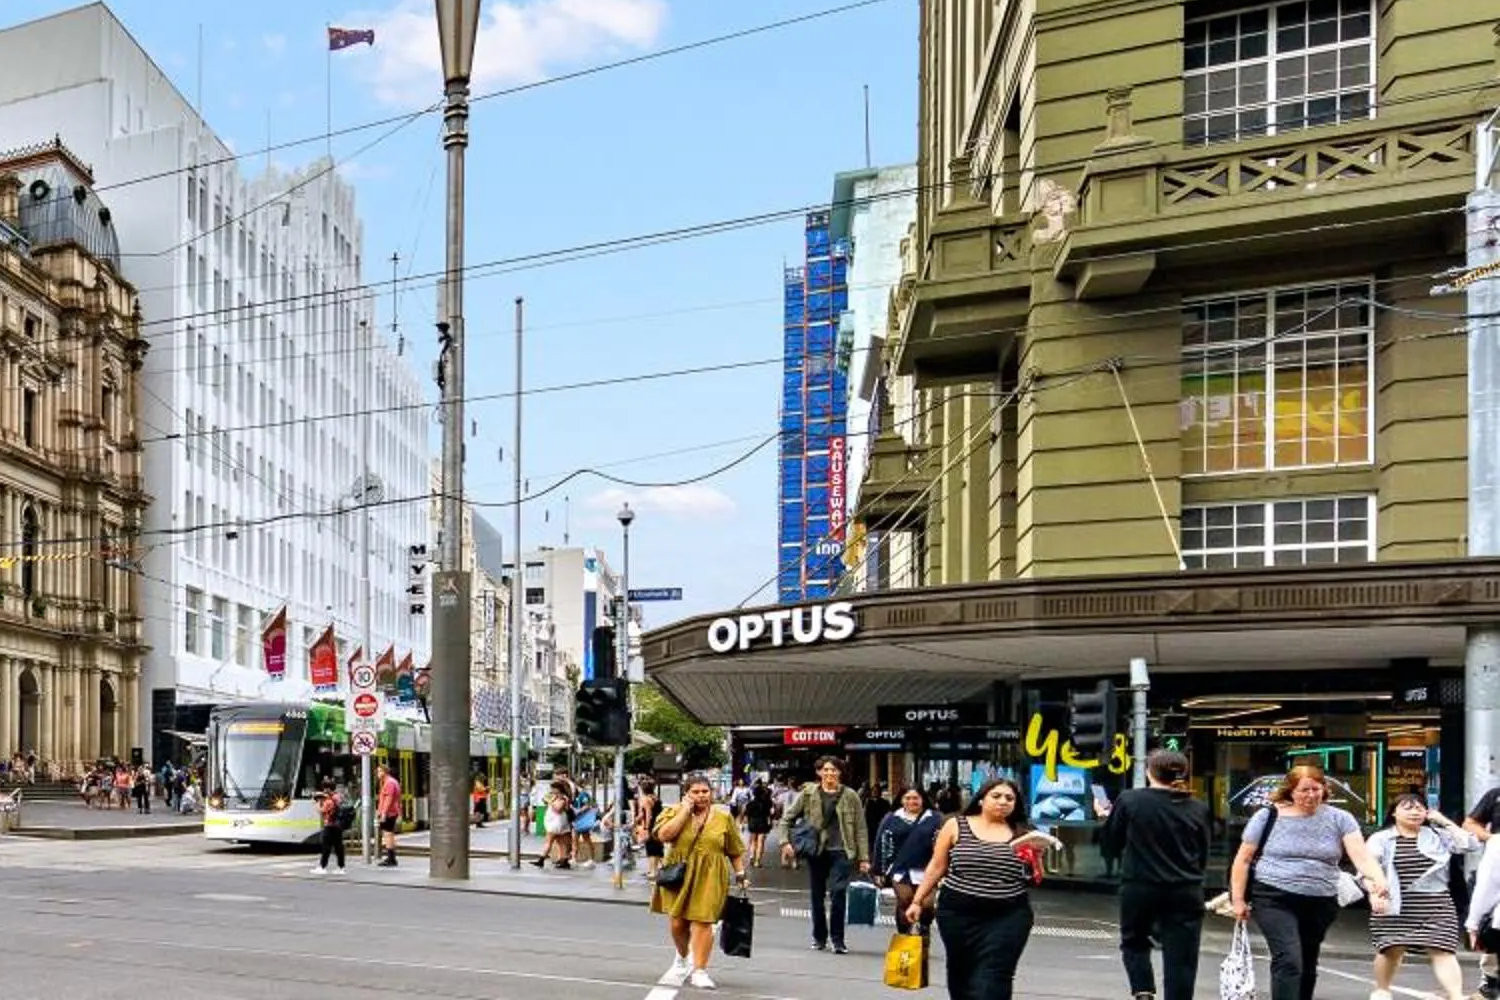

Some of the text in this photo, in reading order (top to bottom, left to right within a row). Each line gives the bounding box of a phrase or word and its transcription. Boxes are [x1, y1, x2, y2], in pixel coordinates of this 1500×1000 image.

[830, 438, 844, 530] CAUSEWAY
[816, 537, 842, 555] inn
[410, 545, 426, 614] MYER
[707, 602, 855, 653] OPTUS
[905, 709, 958, 721] OPTUS
[792, 730, 835, 741] COTTON
[866, 730, 905, 739] OPTUS
[1217, 729, 1256, 737] Health
[1269, 729, 1313, 737] Fitness
